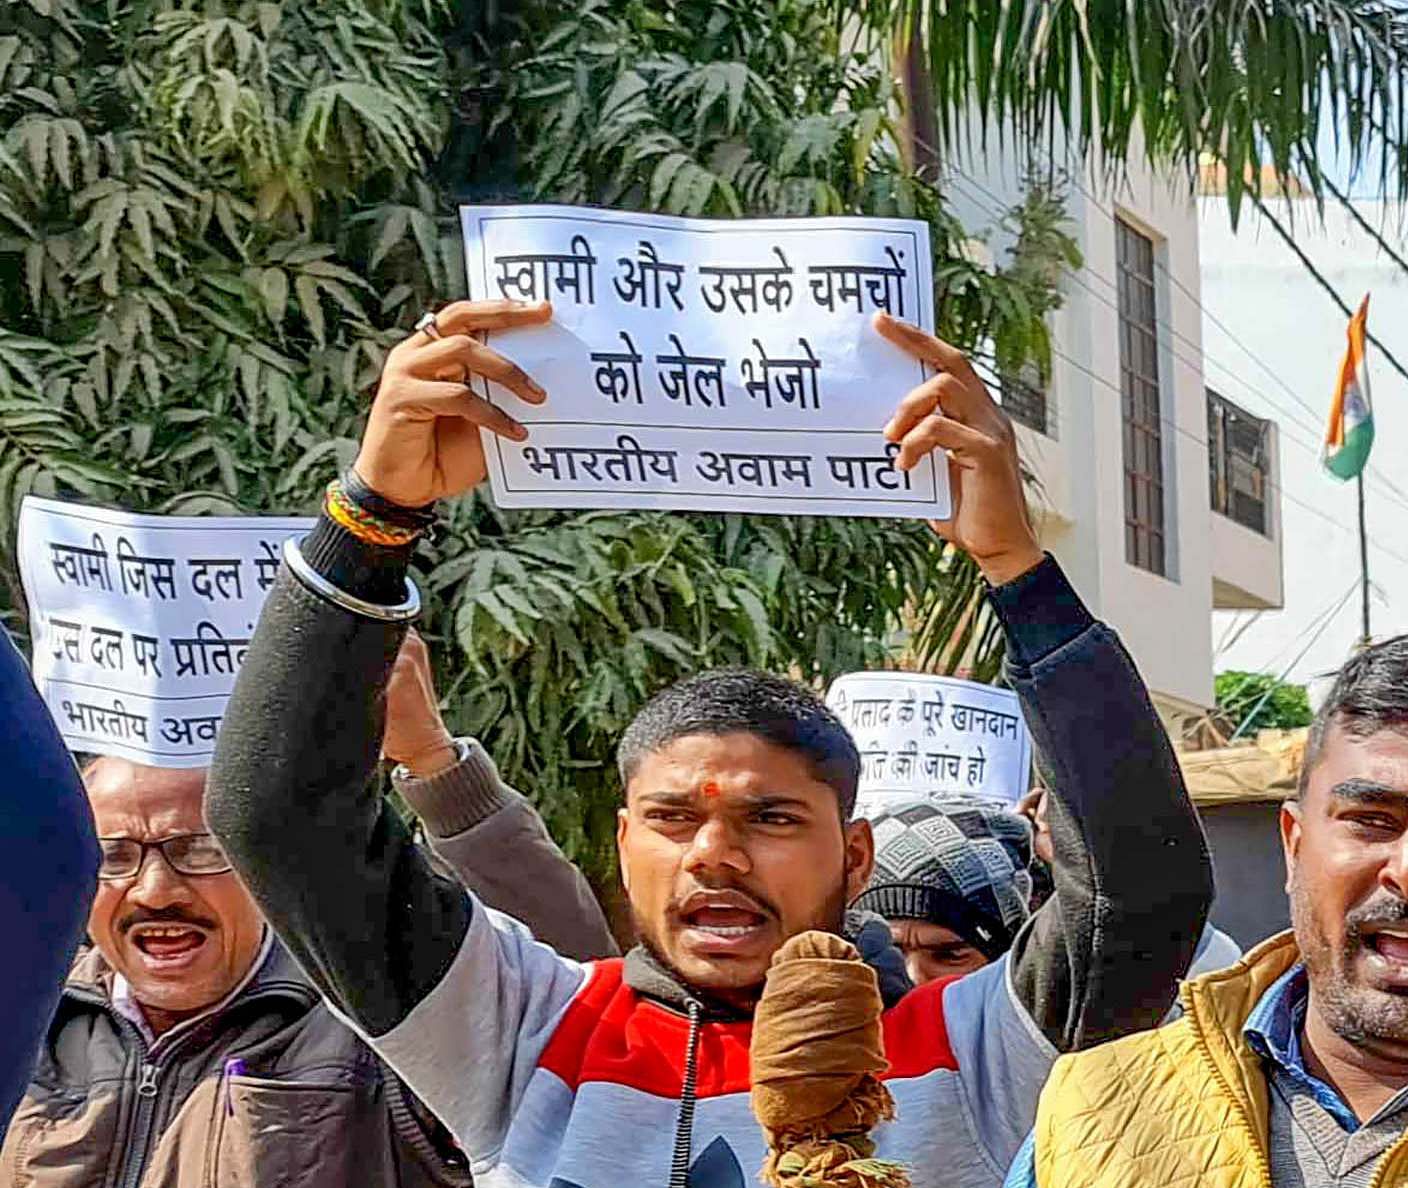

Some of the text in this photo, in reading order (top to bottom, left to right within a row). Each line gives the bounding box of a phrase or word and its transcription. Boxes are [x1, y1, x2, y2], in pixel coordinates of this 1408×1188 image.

[495, 235, 906, 318] स्वामी और उसके चमचों
[591, 331, 822, 410] को जेल भेजो
[522, 435, 678, 484] भारतीय
[695, 451, 813, 488] अवाम
[50, 533, 112, 593] स्वामी
[117, 536, 178, 600] जिस
[187, 558, 243, 601] दल
[90, 626, 124, 672] दल
[131, 633, 162, 679] पर
[61, 699, 149, 744] भारतीय
[923, 690, 944, 738] पूरे
[951, 703, 1020, 741] खानदान
[924, 744, 962, 782] जांच
[966, 746, 987, 787] हो
